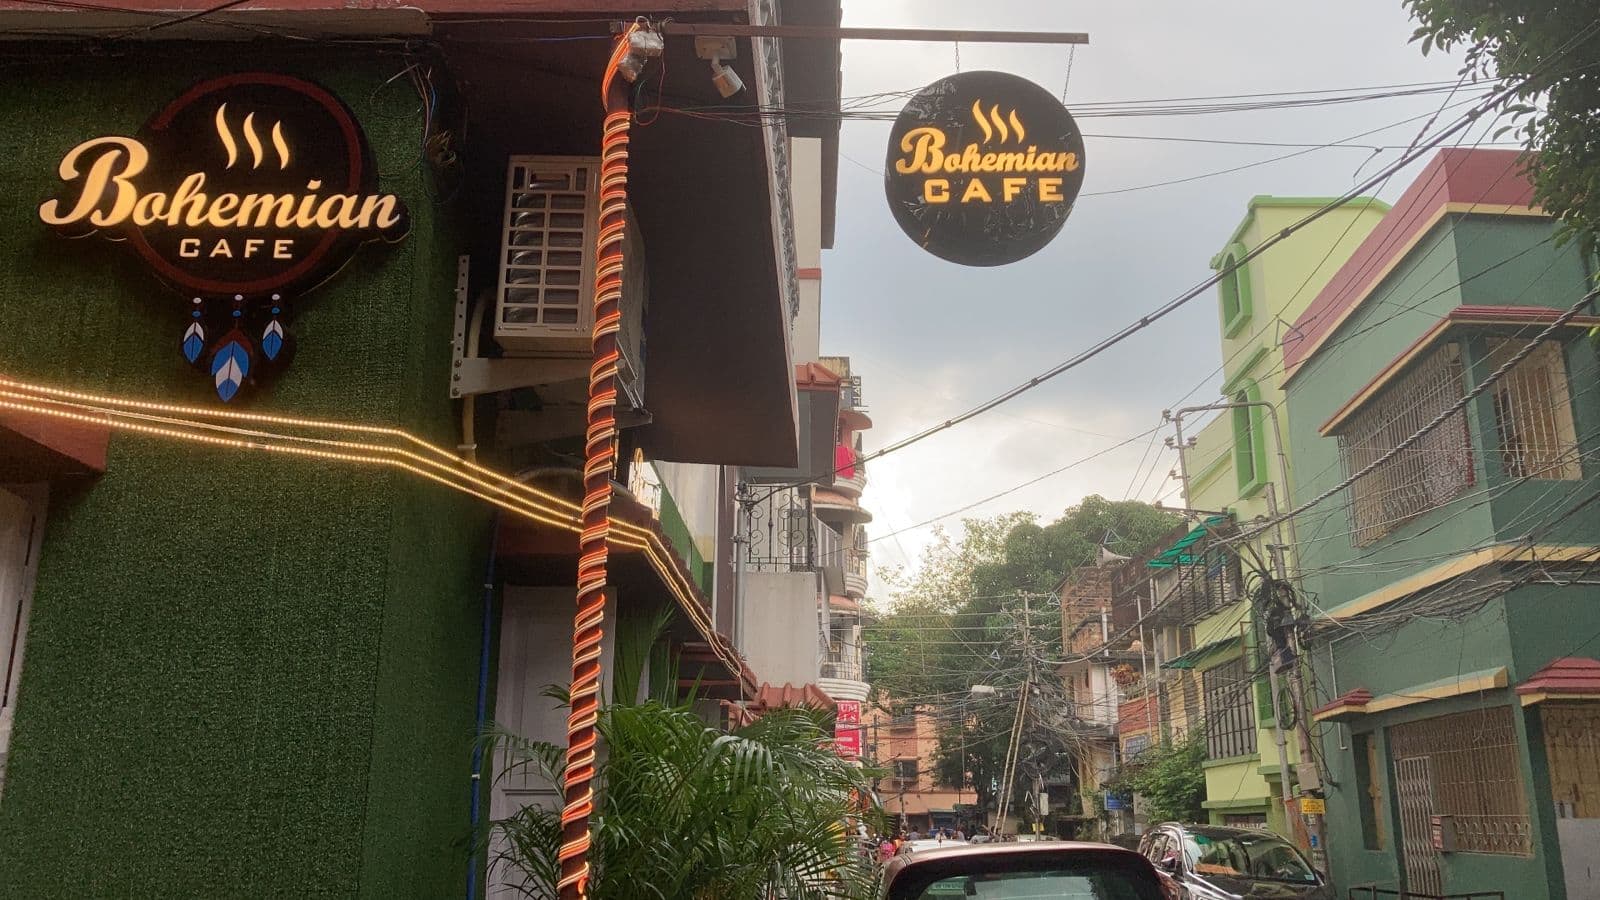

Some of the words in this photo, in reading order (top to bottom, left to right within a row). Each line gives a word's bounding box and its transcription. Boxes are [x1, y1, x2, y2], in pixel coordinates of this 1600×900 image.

[895, 127, 1080, 174] Bohemian
[39, 136, 401, 229] Bohemian
[924, 177, 1064, 203] CAFE
[179, 238, 294, 259] CAFE
